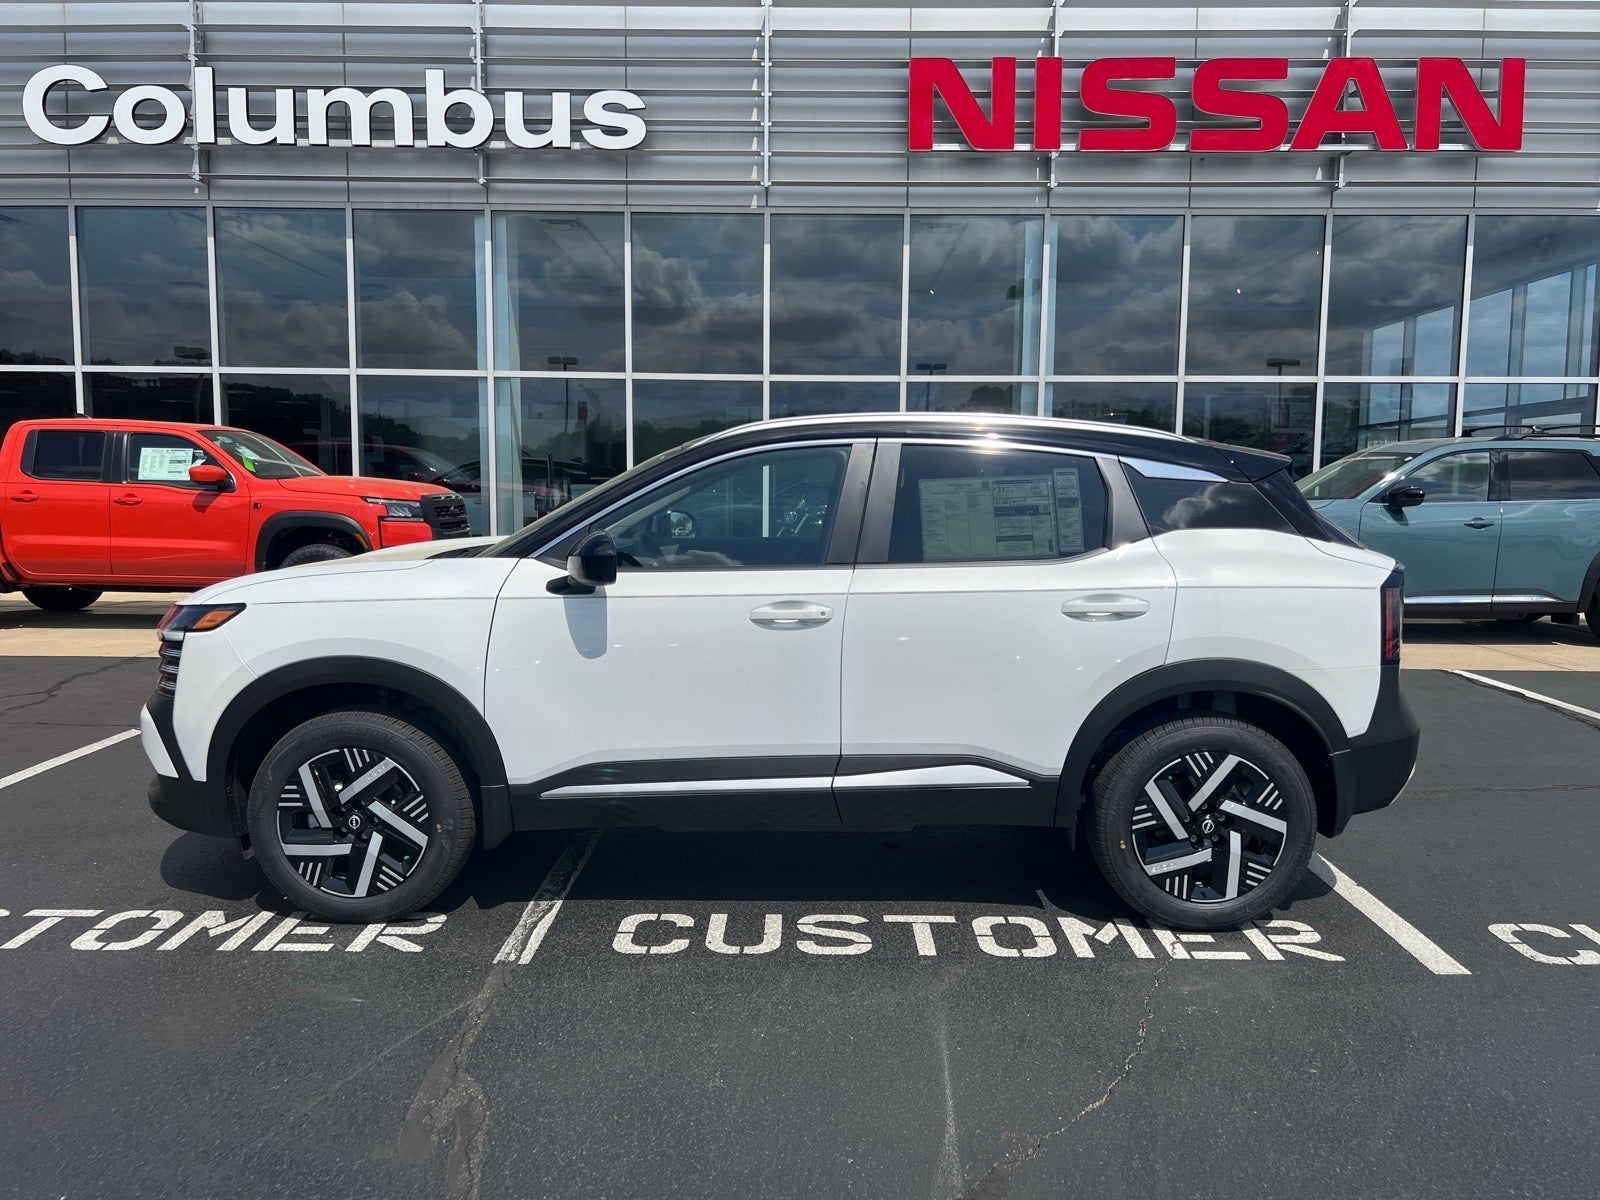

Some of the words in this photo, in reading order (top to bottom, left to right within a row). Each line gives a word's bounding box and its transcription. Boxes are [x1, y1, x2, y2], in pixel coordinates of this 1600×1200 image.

[22, 64, 647, 150] Columbus
[908, 57, 1526, 152] NISSAN
[0, 909, 447, 952] TOMER
[612, 912, 1346, 962] CUSTOMER
